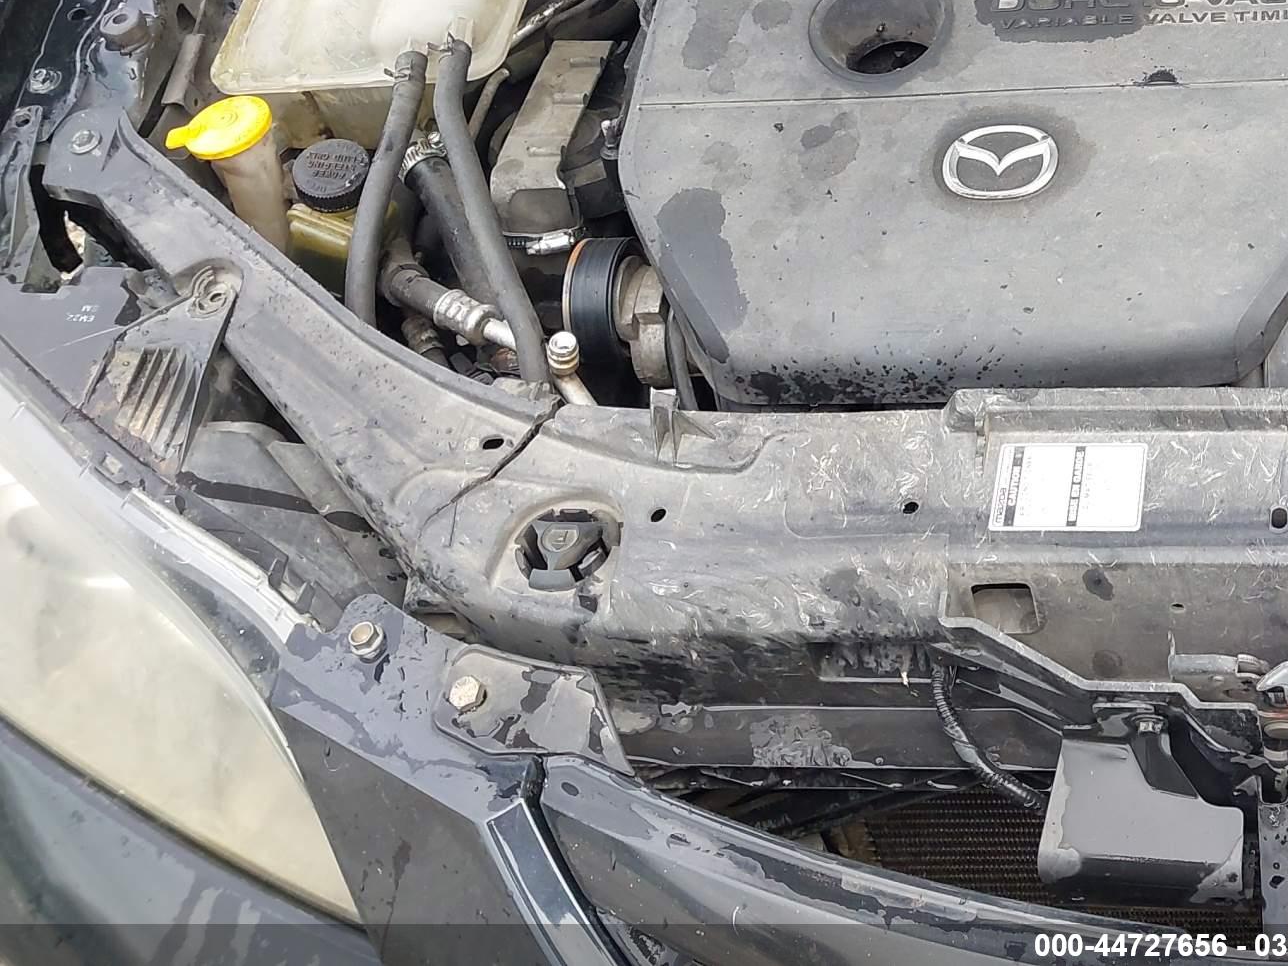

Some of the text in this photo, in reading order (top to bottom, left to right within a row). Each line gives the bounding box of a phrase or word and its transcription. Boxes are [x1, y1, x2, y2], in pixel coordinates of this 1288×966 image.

[1001, 14, 1136, 29] VARIABLE
[1144, 11, 1226, 24] VALVE
[1007, 465, 1022, 506] CAUTION
[995, 487, 1007, 523] mazda
